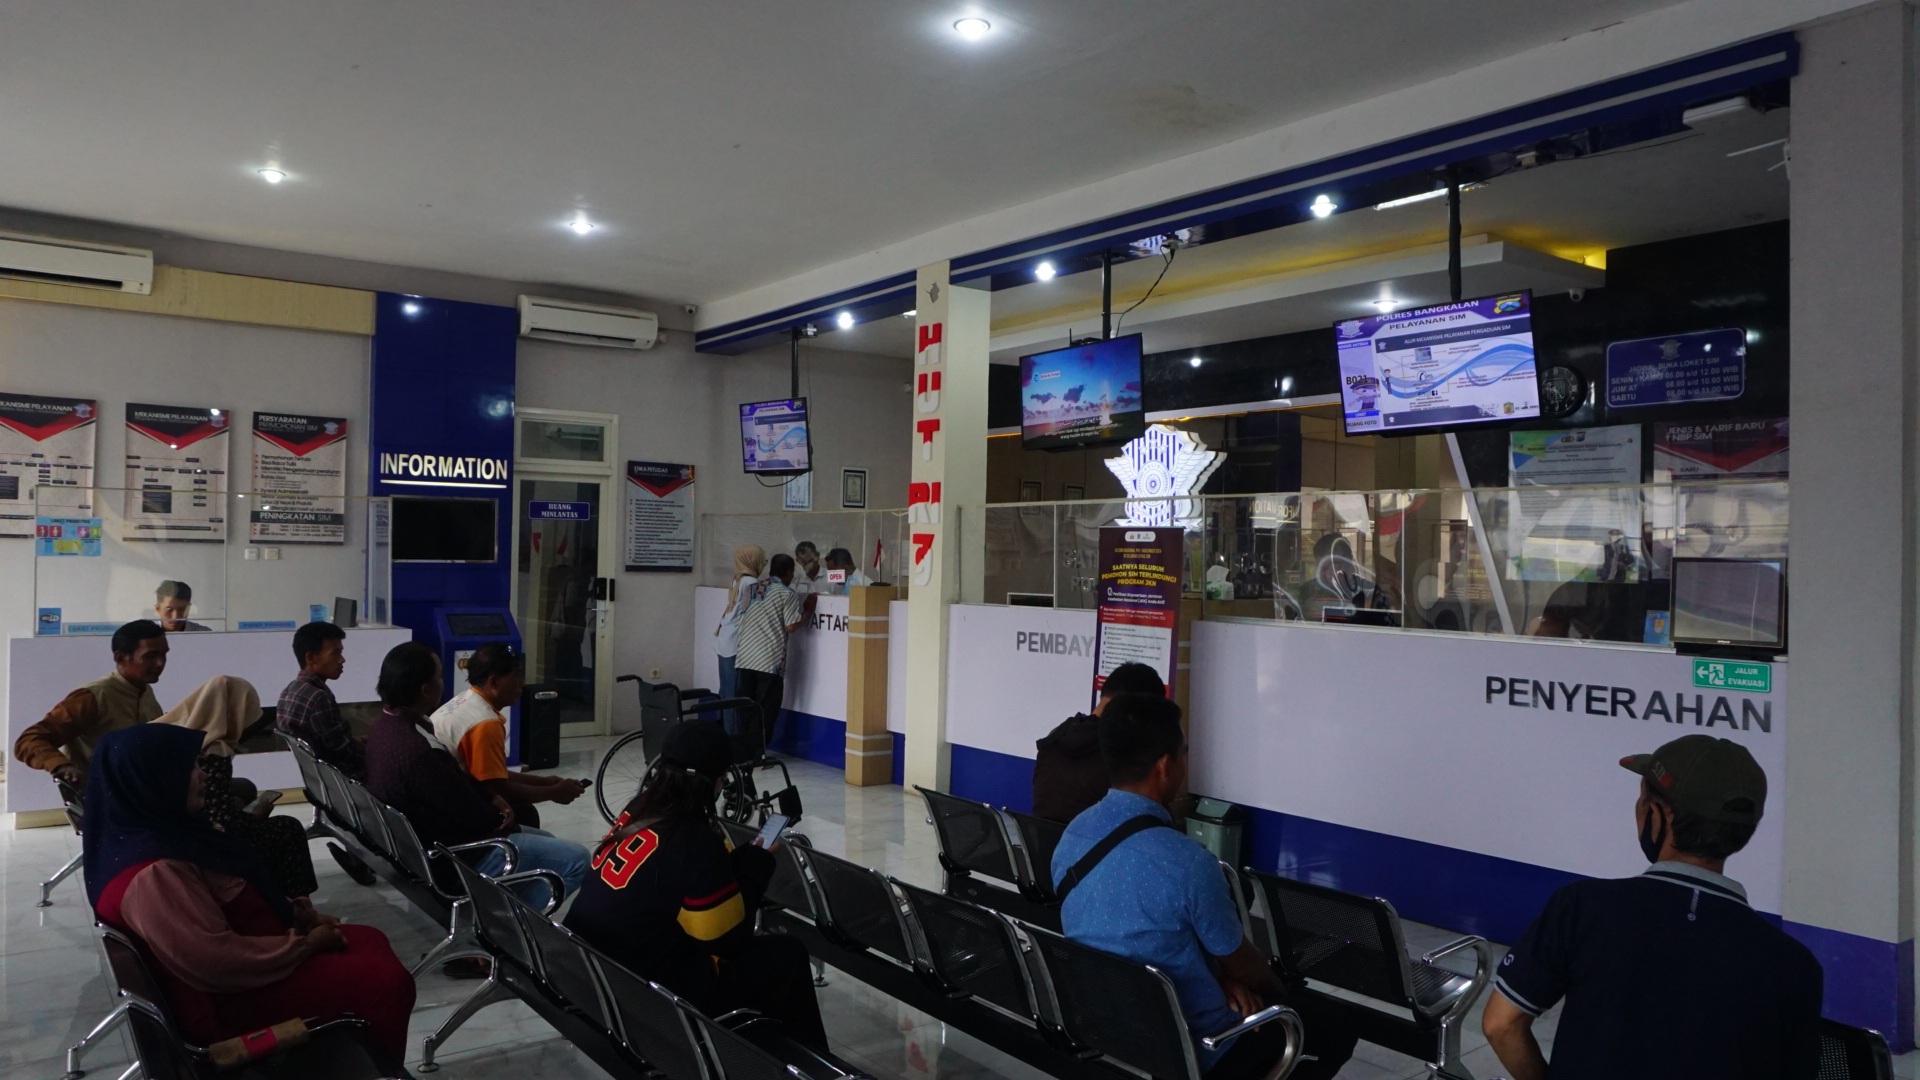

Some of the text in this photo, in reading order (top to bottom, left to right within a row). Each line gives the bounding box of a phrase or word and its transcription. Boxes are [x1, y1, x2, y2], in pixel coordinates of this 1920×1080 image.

[1376, 300, 1479, 323] POLRES BANGKALAN
[1389, 313, 1475, 330] PELAYANAN SIM
[1417, 334, 1444, 343] MEKANISME
[1443, 330, 1470, 339] PELAYANAN
[1470, 326, 1501, 335] PENGADUAN
[1658, 362, 1679, 370] BUKA
[1679, 359, 1704, 367] LOKET
[1346, 375, 1368, 385] B021
[1611, 377, 1634, 385] SENIN
[1639, 373, 1663, 382] KAMIS
[1700, 368, 1720, 376] 12.00
[1723, 374, 1739, 383] WIB
[1611, 393, 1637, 402] SABTU
[1724, 384, 1740, 392] WIB
[31, 403, 73, 412] PELAYANAN
[135, 411, 171, 419] MEKANISME
[171, 414, 208, 422] PELAYANAN
[258, 414, 307, 425] PERSYARATAN
[258, 421, 306, 430] PERMOHONAN
[1667, 426, 1693, 434] JENIS
[1705, 423, 1734, 432] TARIF
[1735, 422, 1766, 431] BARU
[1693, 432, 1713, 440] SIM
[380, 452, 508, 480] INFORMATION
[908, 482, 941, 524] RI
[260, 512, 315, 521] PENINGKATAN
[1112, 563, 1165, 573] SAATNYA SELURUH
[829, 572, 843, 581] OPEN
[1101, 571, 1127, 580] PEMOHON
[1139, 572, 1177, 583] TERLINDUNGI
[808, 613, 849, 632] AFTAR
[1016, 631, 1097, 657] PEMBAY
[1735, 666, 1759, 675] JALUR
[1727, 677, 1765, 688] EVAKUASI
[1485, 676, 1771, 733] PENYERAHAN
